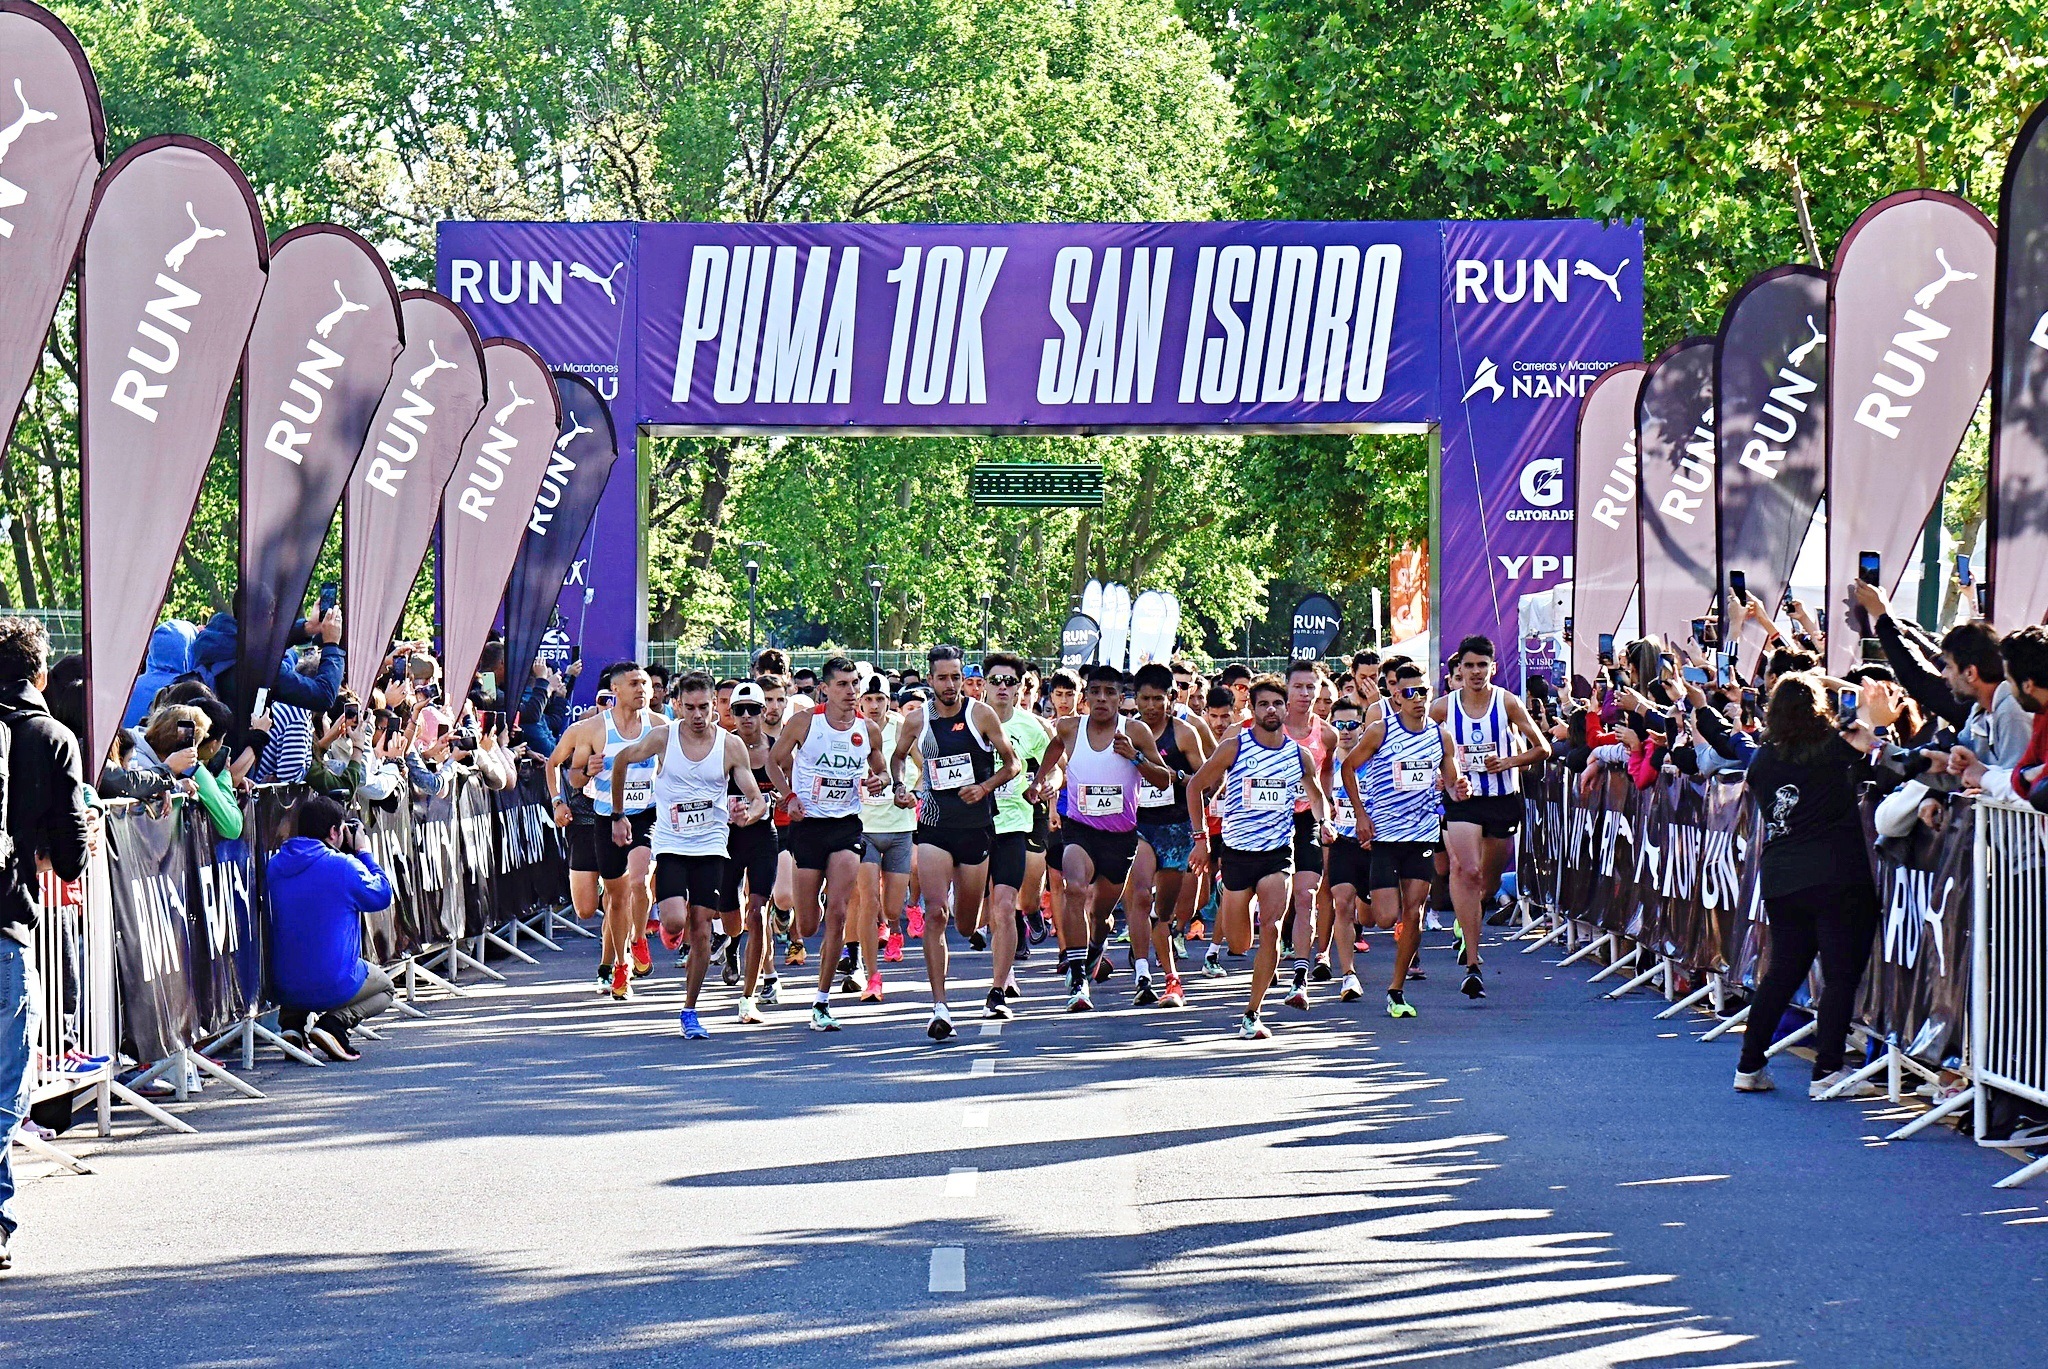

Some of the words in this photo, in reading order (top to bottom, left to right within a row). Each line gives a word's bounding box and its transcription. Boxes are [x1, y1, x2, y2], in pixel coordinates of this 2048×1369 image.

[452, 260, 562, 304] RUN
[1455, 258, 1568, 304] RUN
[671, 245, 860, 404] PUMA
[882, 245, 1008, 404] 10K
[1037, 245, 1173, 405] SAN
[1178, 244, 1402, 404] ISIDRO
[111, 272, 202, 424] RUN
[563, 362, 619, 373] Maratones
[1512, 360, 1557, 371] Carreras
[1559, 362, 1566, 373] y
[1568, 360, 1619, 371] Maraton
[1853, 309, 1951, 440] RUN
[264, 339, 345, 465] RUN
[1739, 367, 1818, 480] RUN
[365, 389, 436, 498] RUN
[458, 425, 518, 523] RUN
[1659, 426, 1715, 525] RUN
[528, 451, 577, 536] RUN
[1293, 614, 1326, 630] RUN
[1063, 630, 1088, 641] RUN
[1061, 653, 1082, 666] 4:30
[1290, 646, 1317, 661] 4:00
[815, 752, 862, 770] ADN
[949, 768, 962, 780] A4
[1411, 772, 1424, 782] A2
[625, 792, 644, 801] A60
[826, 789, 847, 800] A27
[1149, 791, 1163, 799] A3
[1258, 791, 1279, 801] A10
[1097, 798, 1112, 808] A6
[686, 812, 706, 825] A11
